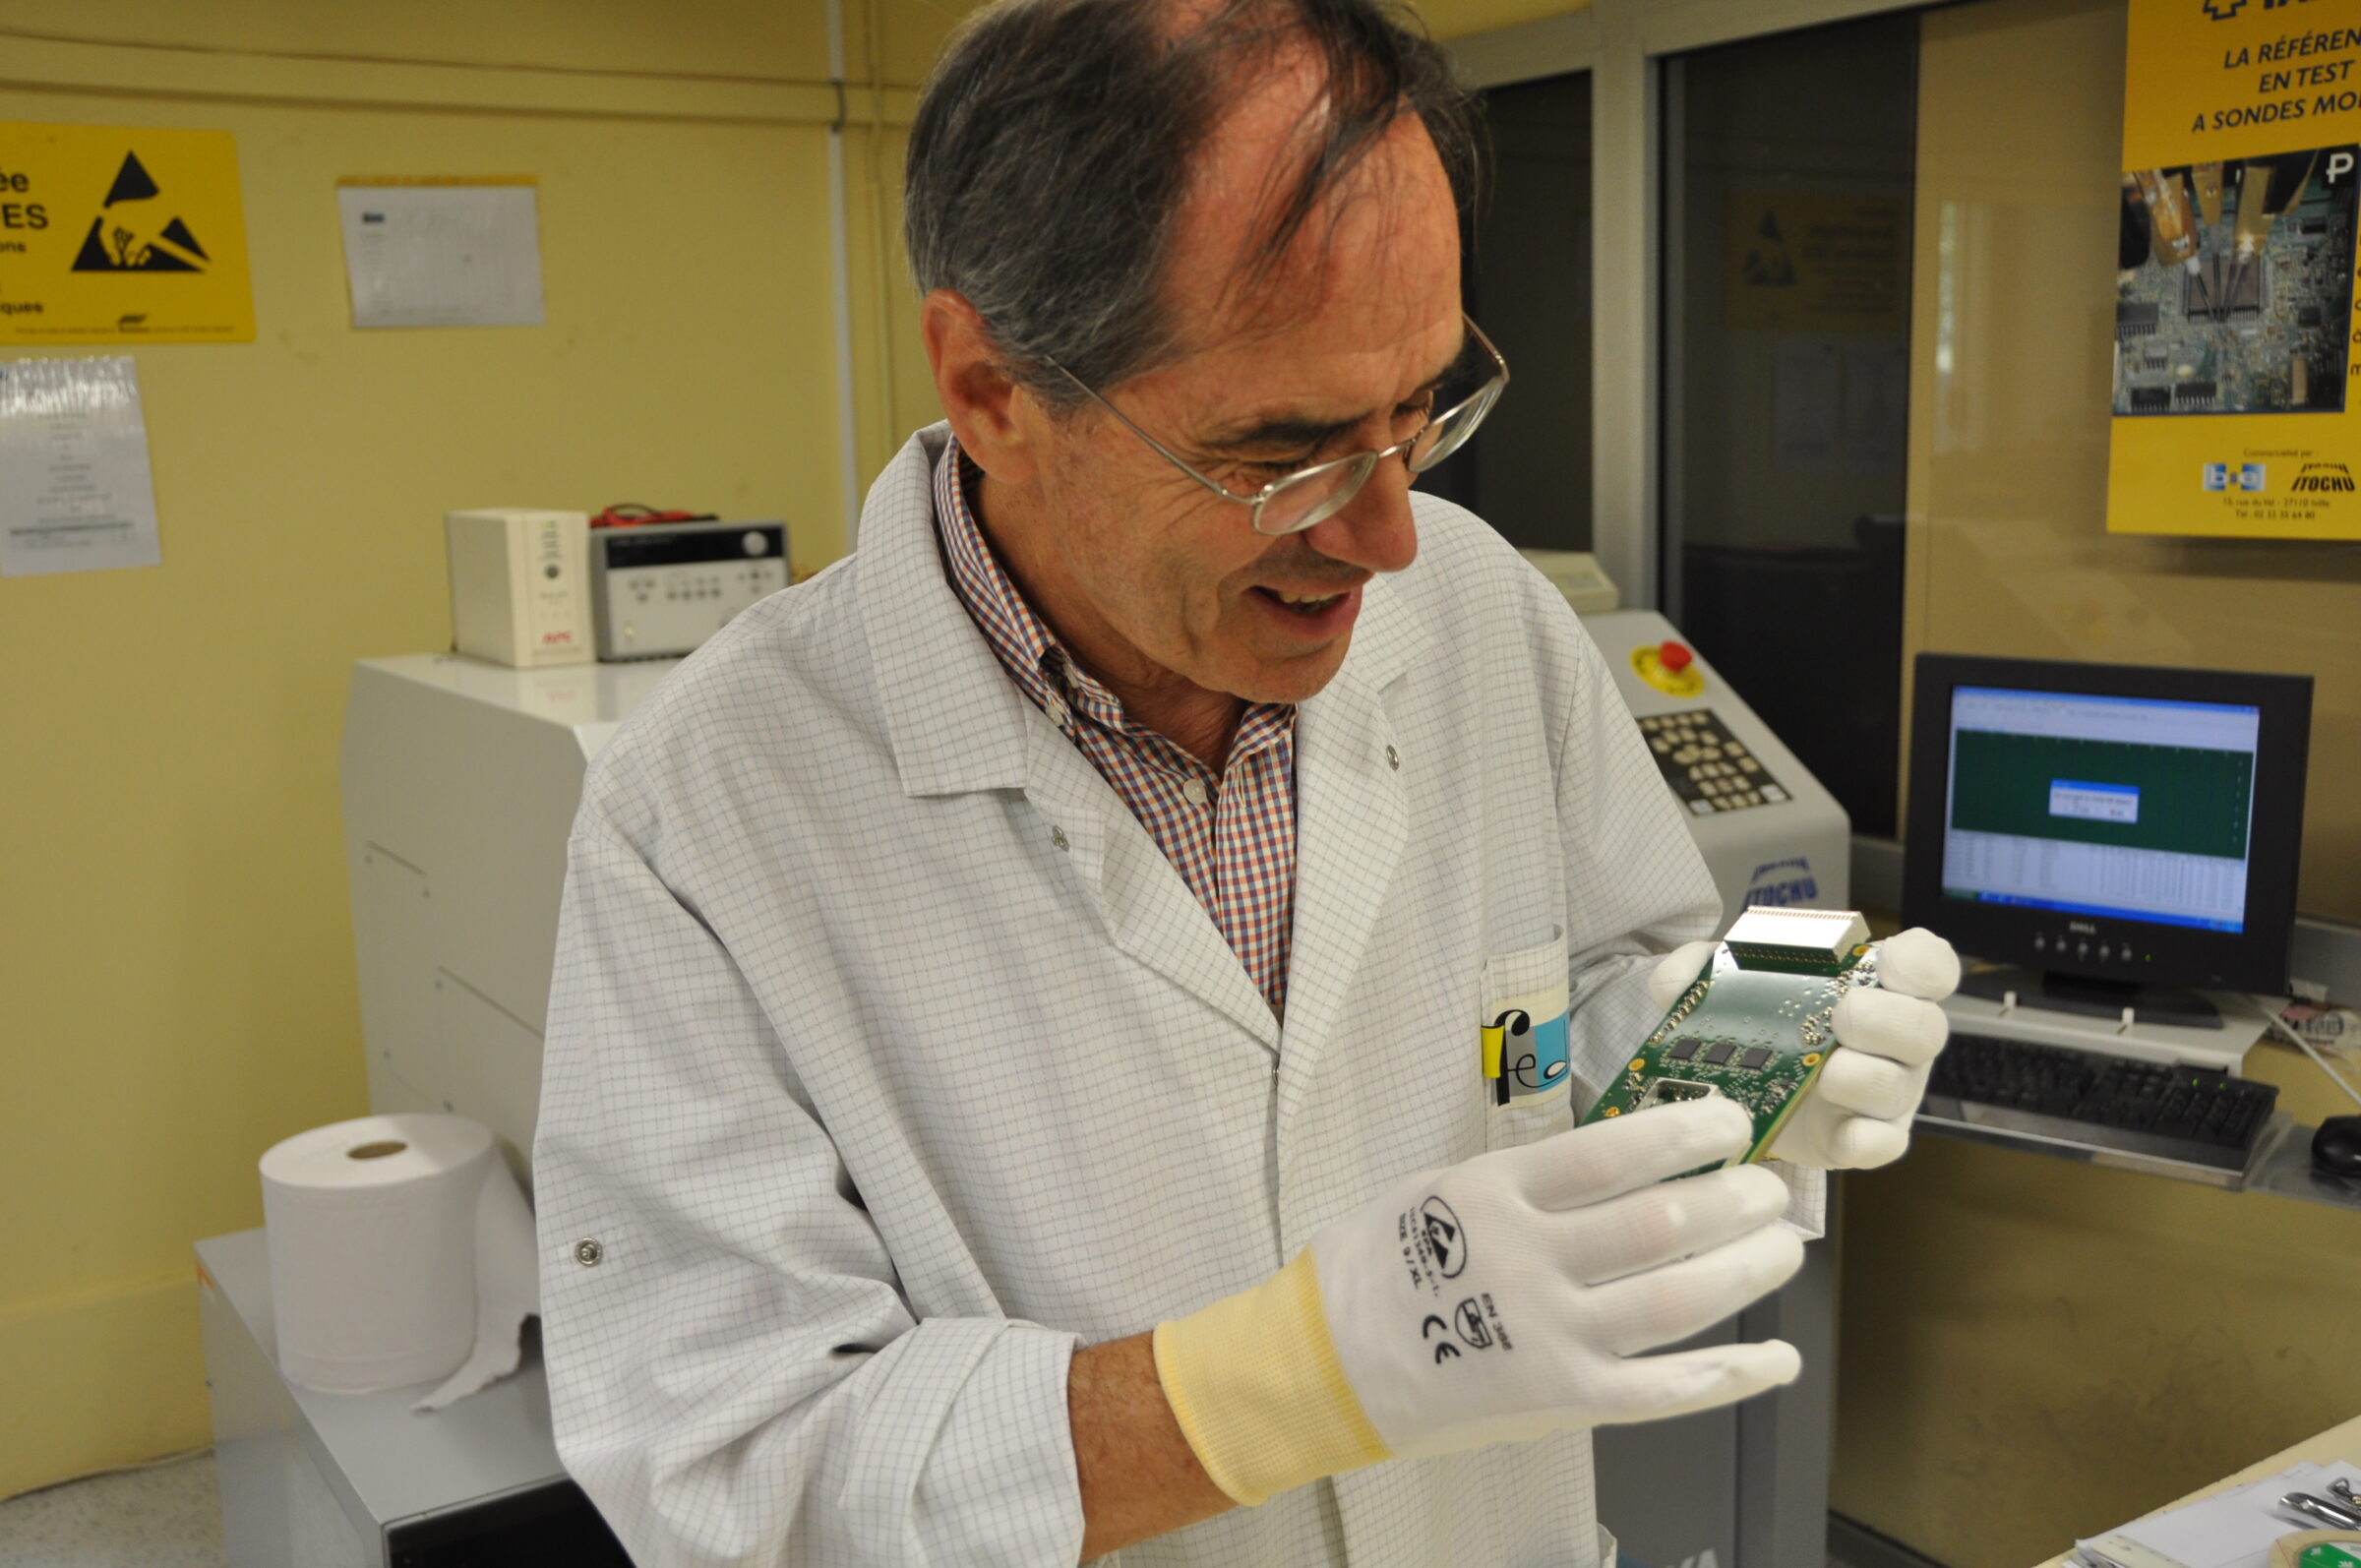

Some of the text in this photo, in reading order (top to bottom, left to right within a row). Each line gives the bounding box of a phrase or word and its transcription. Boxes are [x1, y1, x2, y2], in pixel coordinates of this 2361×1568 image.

[2224, 47, 2250, 69] LA
[2259, 59, 2355, 93] EN TEST
[2192, 90, 2361, 133] A SONDES MO
[2291, 476, 2356, 492] ITOCHU
[1481, 1292, 1498, 1319] EN
